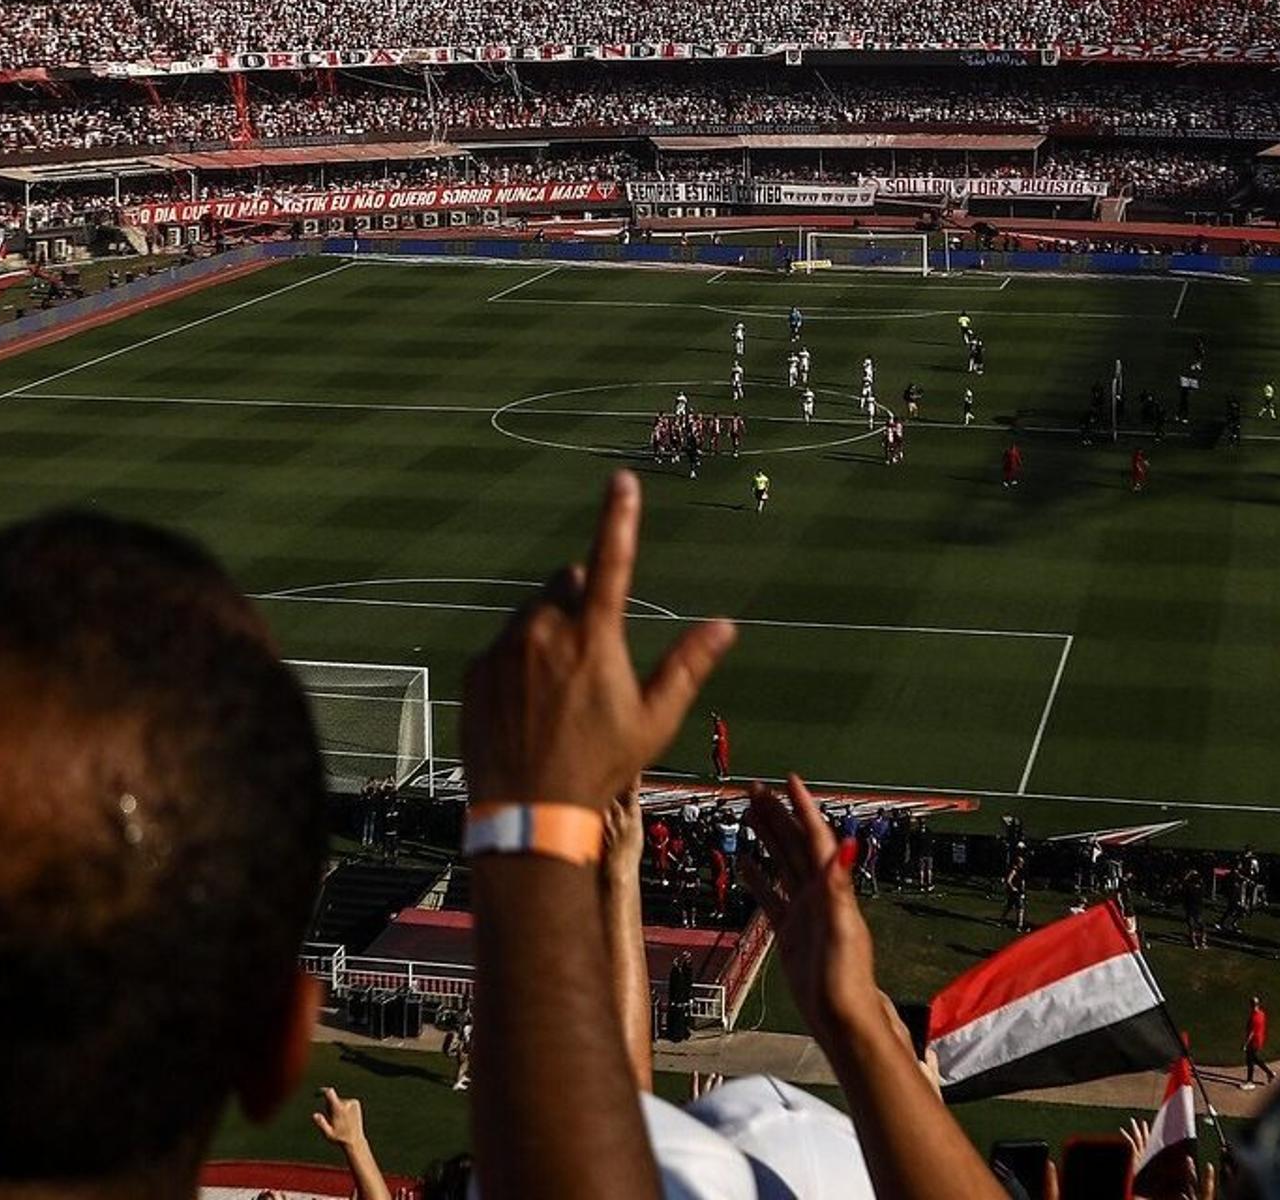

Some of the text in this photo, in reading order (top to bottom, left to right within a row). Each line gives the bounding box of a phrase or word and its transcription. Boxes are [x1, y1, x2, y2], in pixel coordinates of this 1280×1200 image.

[153, 207, 177, 223] DIA
[182, 204, 211, 222] QUE
[215, 203, 233, 219] TU
[330, 195, 349, 211] EU
[387, 190, 436, 209] QUERO
[440, 186, 493, 206] SORRIR
[494, 184, 547, 204] NUNCA
[548, 183, 591, 202] MAIS!
